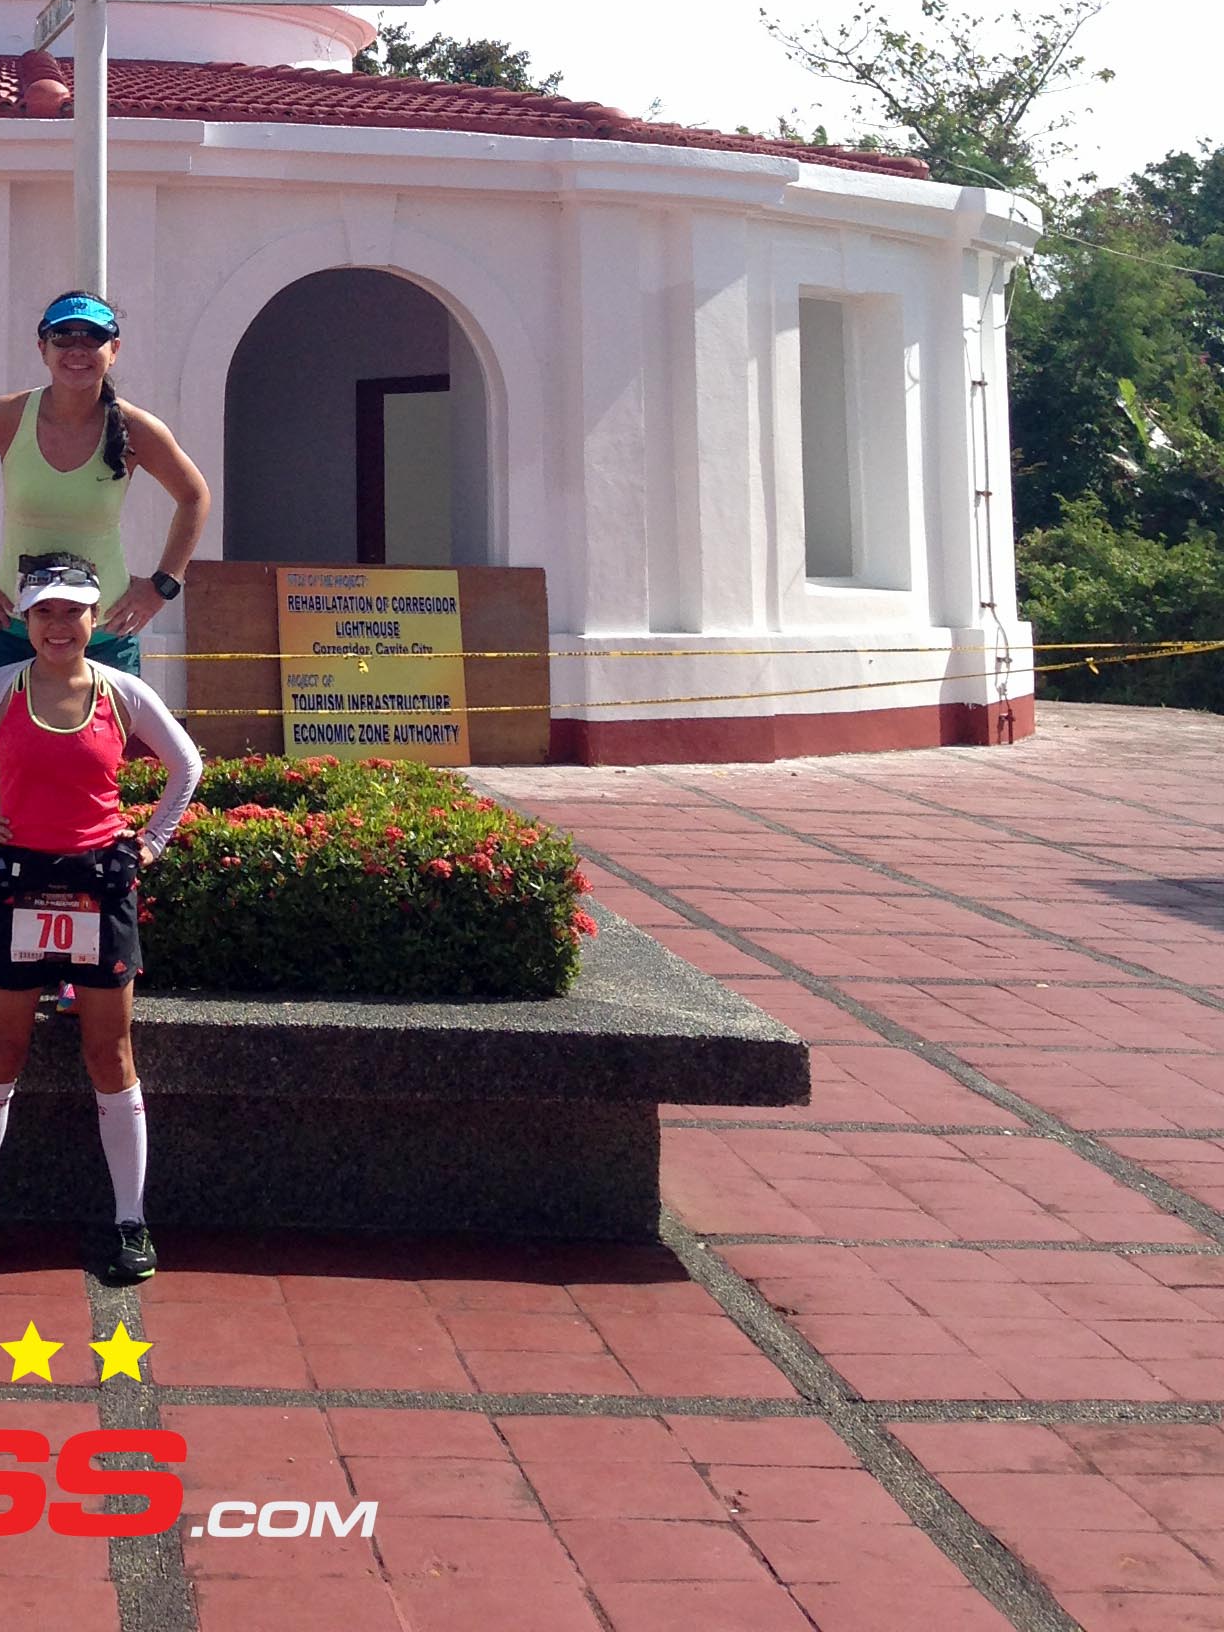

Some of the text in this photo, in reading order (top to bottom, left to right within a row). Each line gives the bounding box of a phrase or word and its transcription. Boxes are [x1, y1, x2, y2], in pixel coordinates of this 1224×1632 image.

[376, 596, 389, 612] OF
[391, 596, 457, 613] CORREGIDOR
[336, 621, 400, 638] LIGHTHOUSE
[376, 642, 409, 655] Cavite
[411, 642, 434, 656] City
[292, 694, 451, 712] TOURISM INFRASTRUCTURE
[293, 724, 458, 743] ECONOMIC ZONE AUTHORITY
[36, 913, 73, 950] 70
